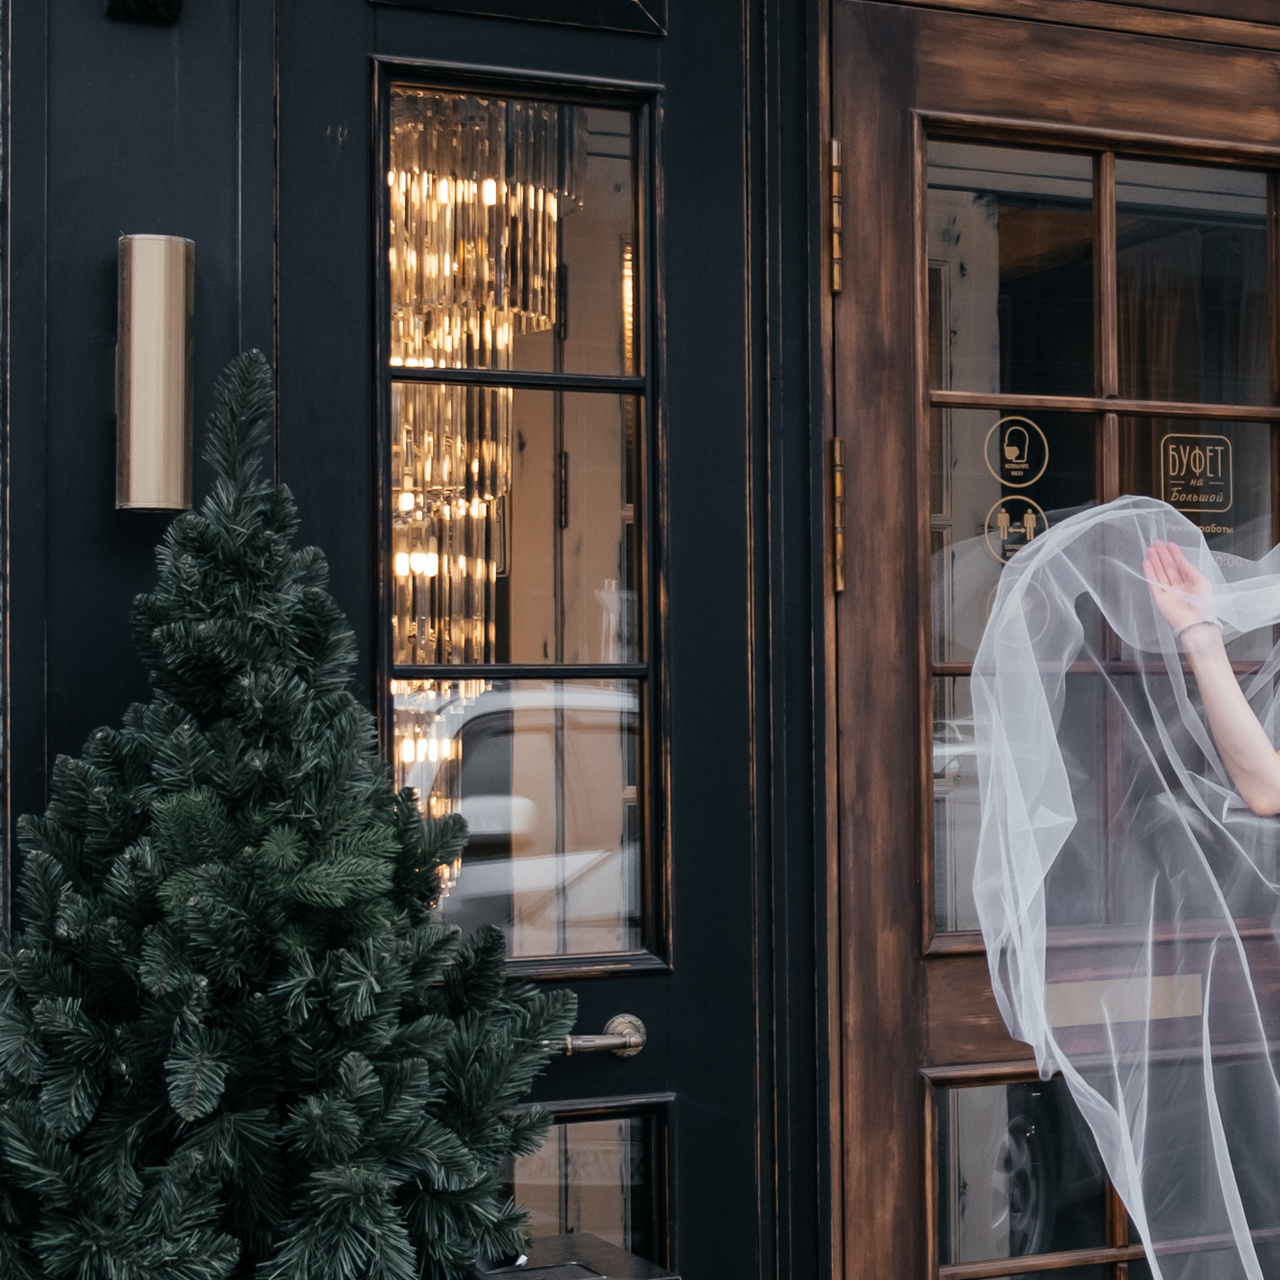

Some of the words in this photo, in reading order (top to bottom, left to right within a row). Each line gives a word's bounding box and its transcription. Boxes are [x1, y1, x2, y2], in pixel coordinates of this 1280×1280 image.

[1168, 444, 1225, 478] БУФЕТ
[1189, 478, 1204, 486] на
[1170, 487, 1224, 502] Большой
